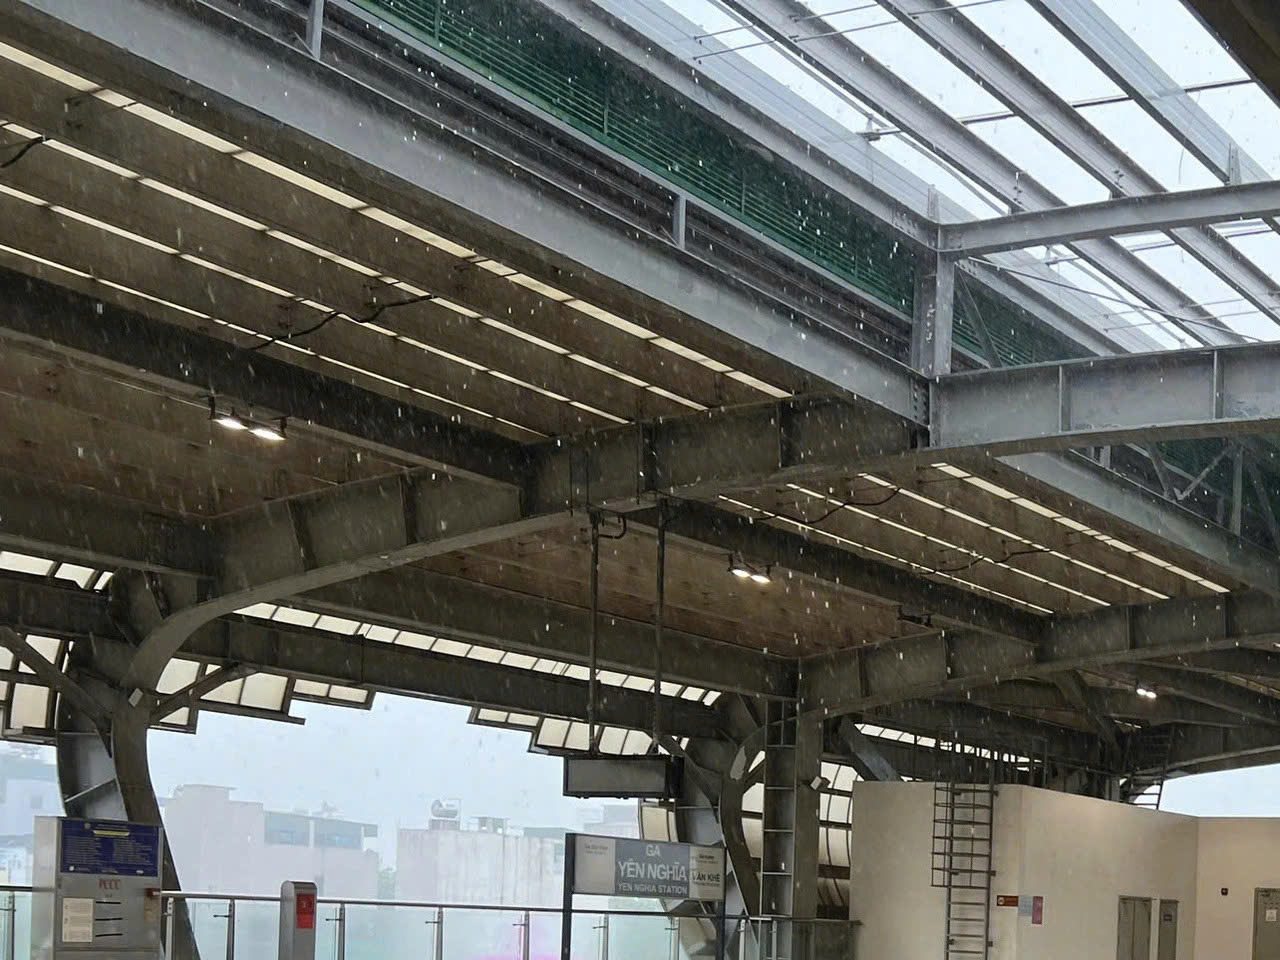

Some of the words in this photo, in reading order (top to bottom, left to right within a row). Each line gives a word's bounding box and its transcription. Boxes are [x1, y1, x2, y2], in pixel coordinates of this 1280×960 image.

[646, 844, 660, 857] GA
[618, 858, 646, 880] YÊN
[647, 862, 688, 881] NGHĨA
[619, 882, 633, 891] YEN
[634, 883, 657, 893] NGHIA
[658, 885, 688, 894] STATION
